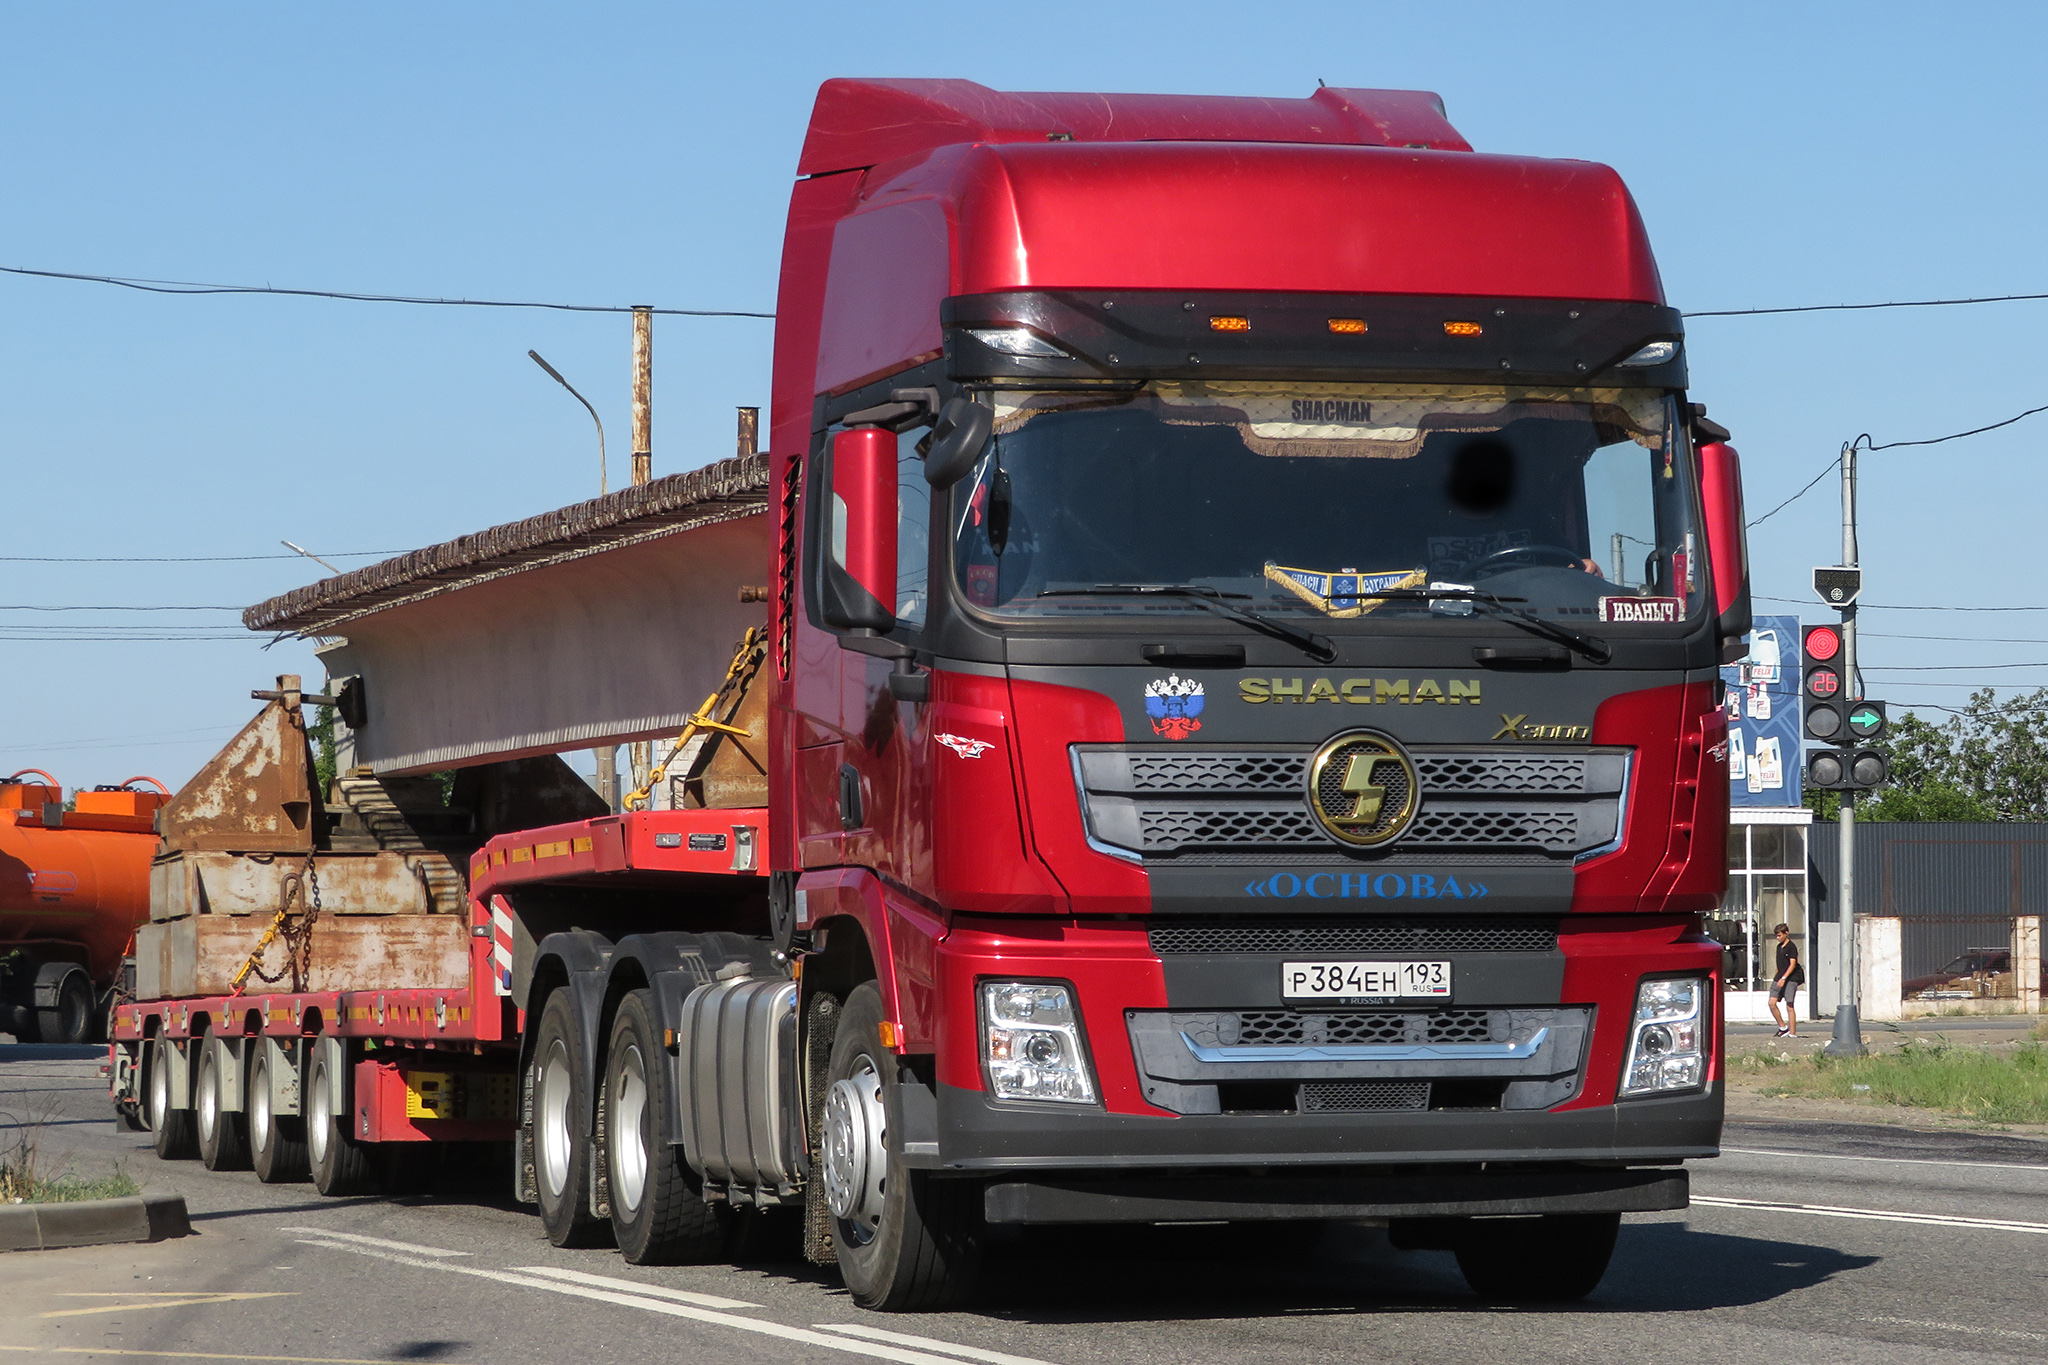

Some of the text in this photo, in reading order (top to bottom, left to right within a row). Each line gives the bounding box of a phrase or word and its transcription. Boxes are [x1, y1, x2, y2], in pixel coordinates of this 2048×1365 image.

[1291, 399, 1372, 422] SHACMAN
[1612, 602, 1674, 622] ИВАНЫЧ
[1239, 678, 1481, 705] SHACMAN
[1813, 672, 1838, 692] 26
[1490, 713, 1590, 741] X3000
[1244, 872, 1489, 899] «ОСНОВА»
[1404, 963, 1443, 984] 193
[1412, 985, 1432, 993] RUS
[1350, 997, 1384, 1005] RUSSIA
